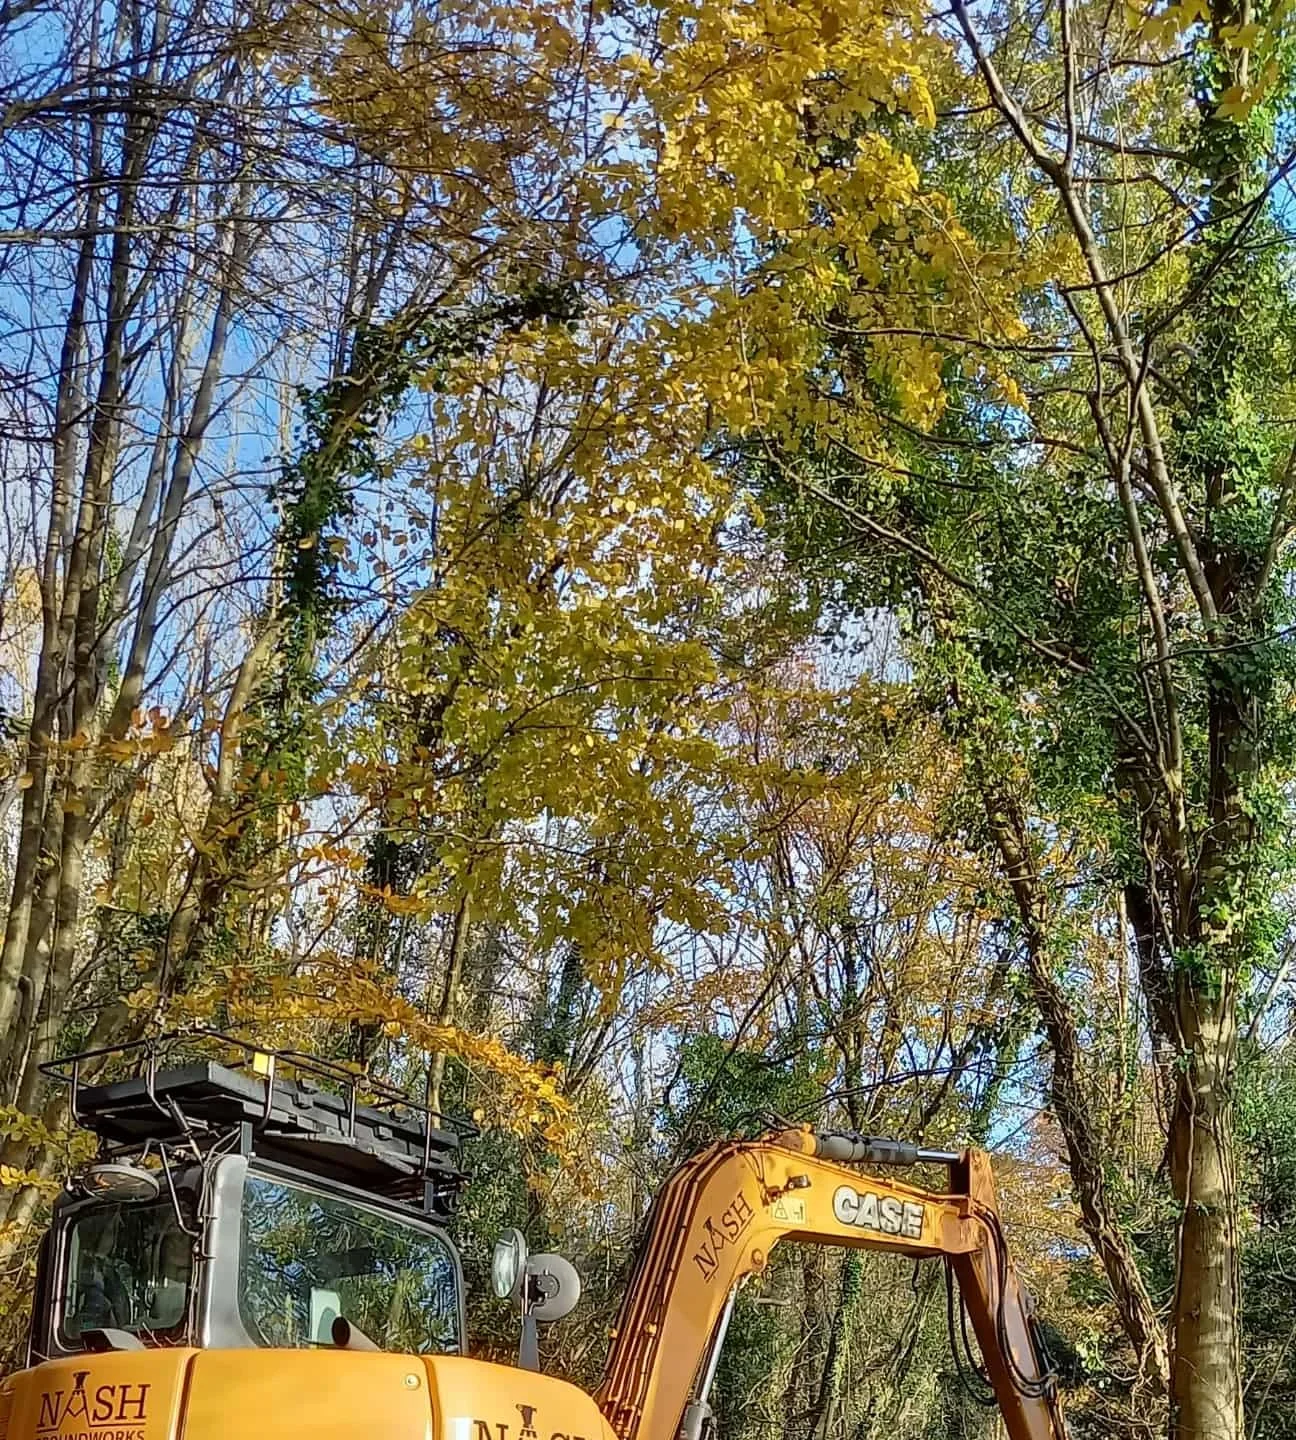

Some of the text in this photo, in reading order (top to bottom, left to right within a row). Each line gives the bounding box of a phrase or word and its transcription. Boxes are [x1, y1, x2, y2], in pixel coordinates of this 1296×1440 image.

[693, 1191, 756, 1283] NASH
[833, 1184, 925, 1241] CASE
[36, 1371, 151, 1433] NASH
